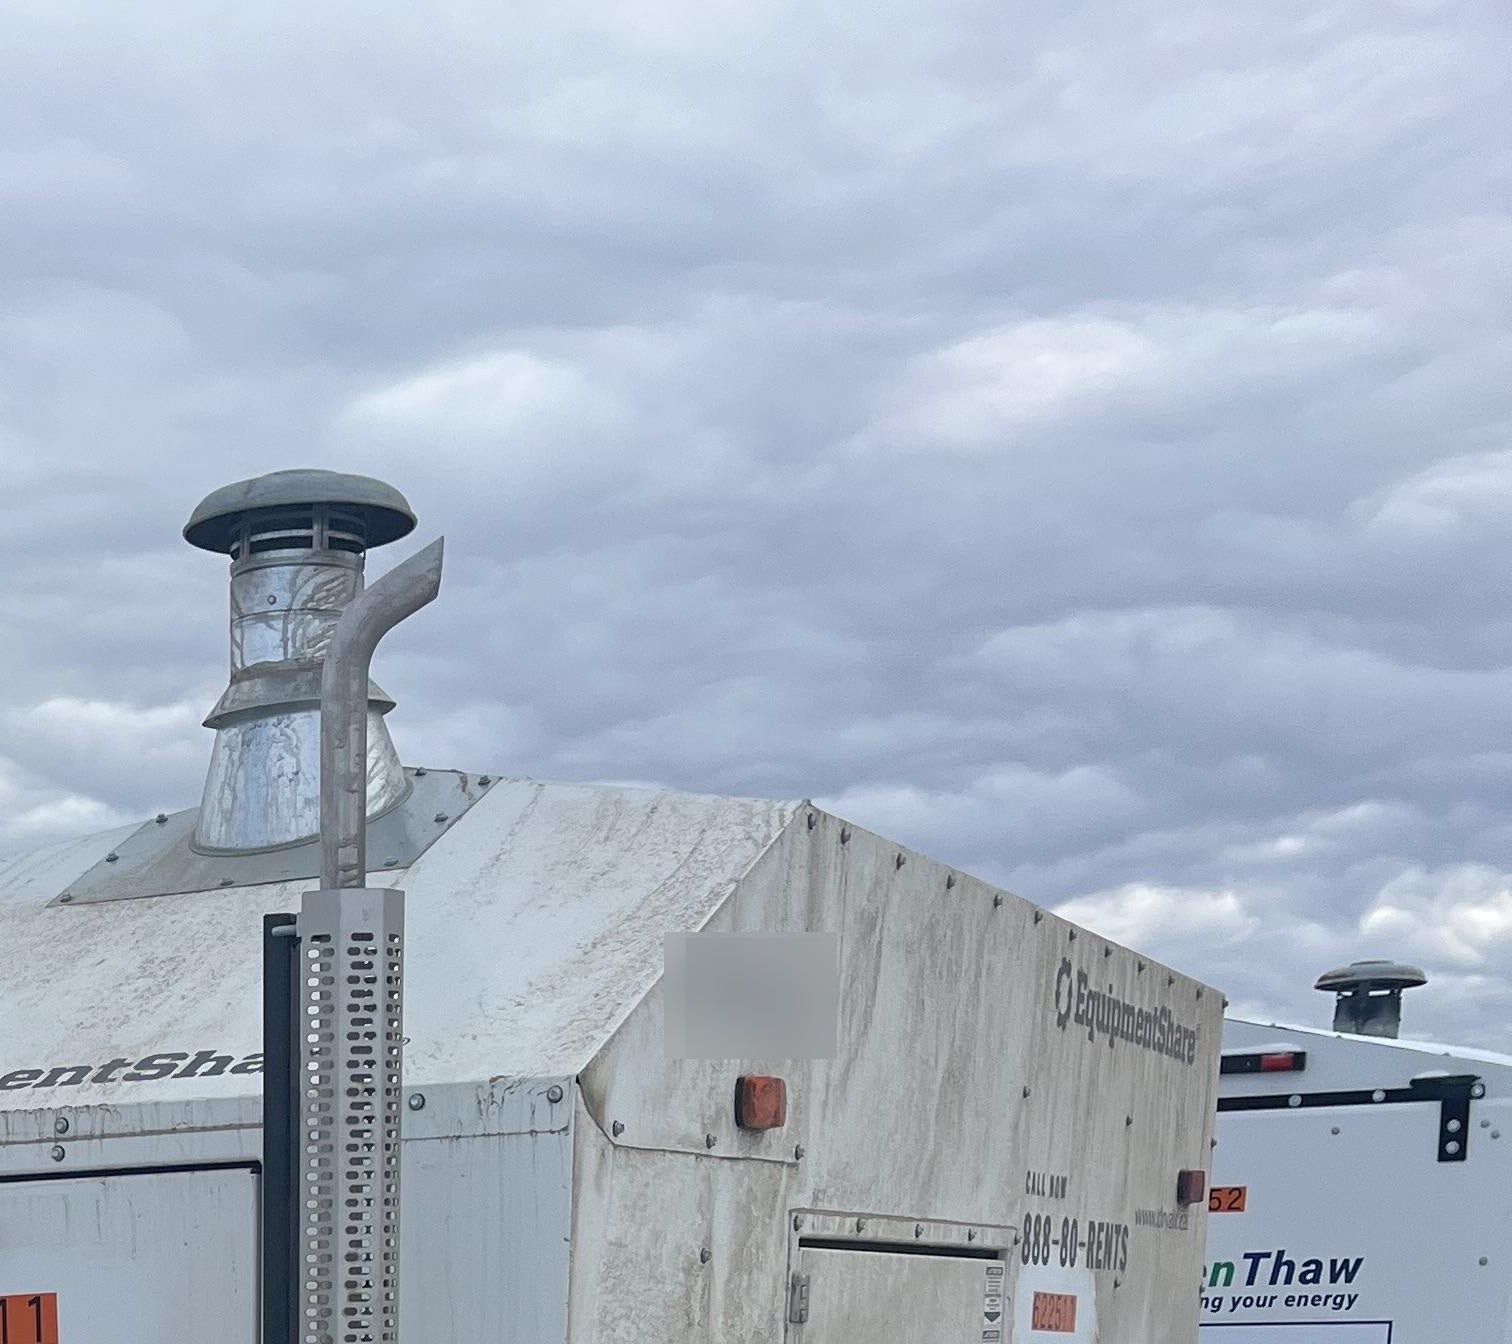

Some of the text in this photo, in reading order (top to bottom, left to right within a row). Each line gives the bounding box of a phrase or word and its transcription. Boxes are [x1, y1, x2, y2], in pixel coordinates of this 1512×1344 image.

[1074, 966, 1197, 1067] EquipmentShare
[1025, 1170, 1068, 1199] CALL NOW
[1021, 1212, 1130, 1272] 888-80-RENTS
[1229, 1294, 1278, 1313] your
[1284, 1292, 1360, 1312] energy
